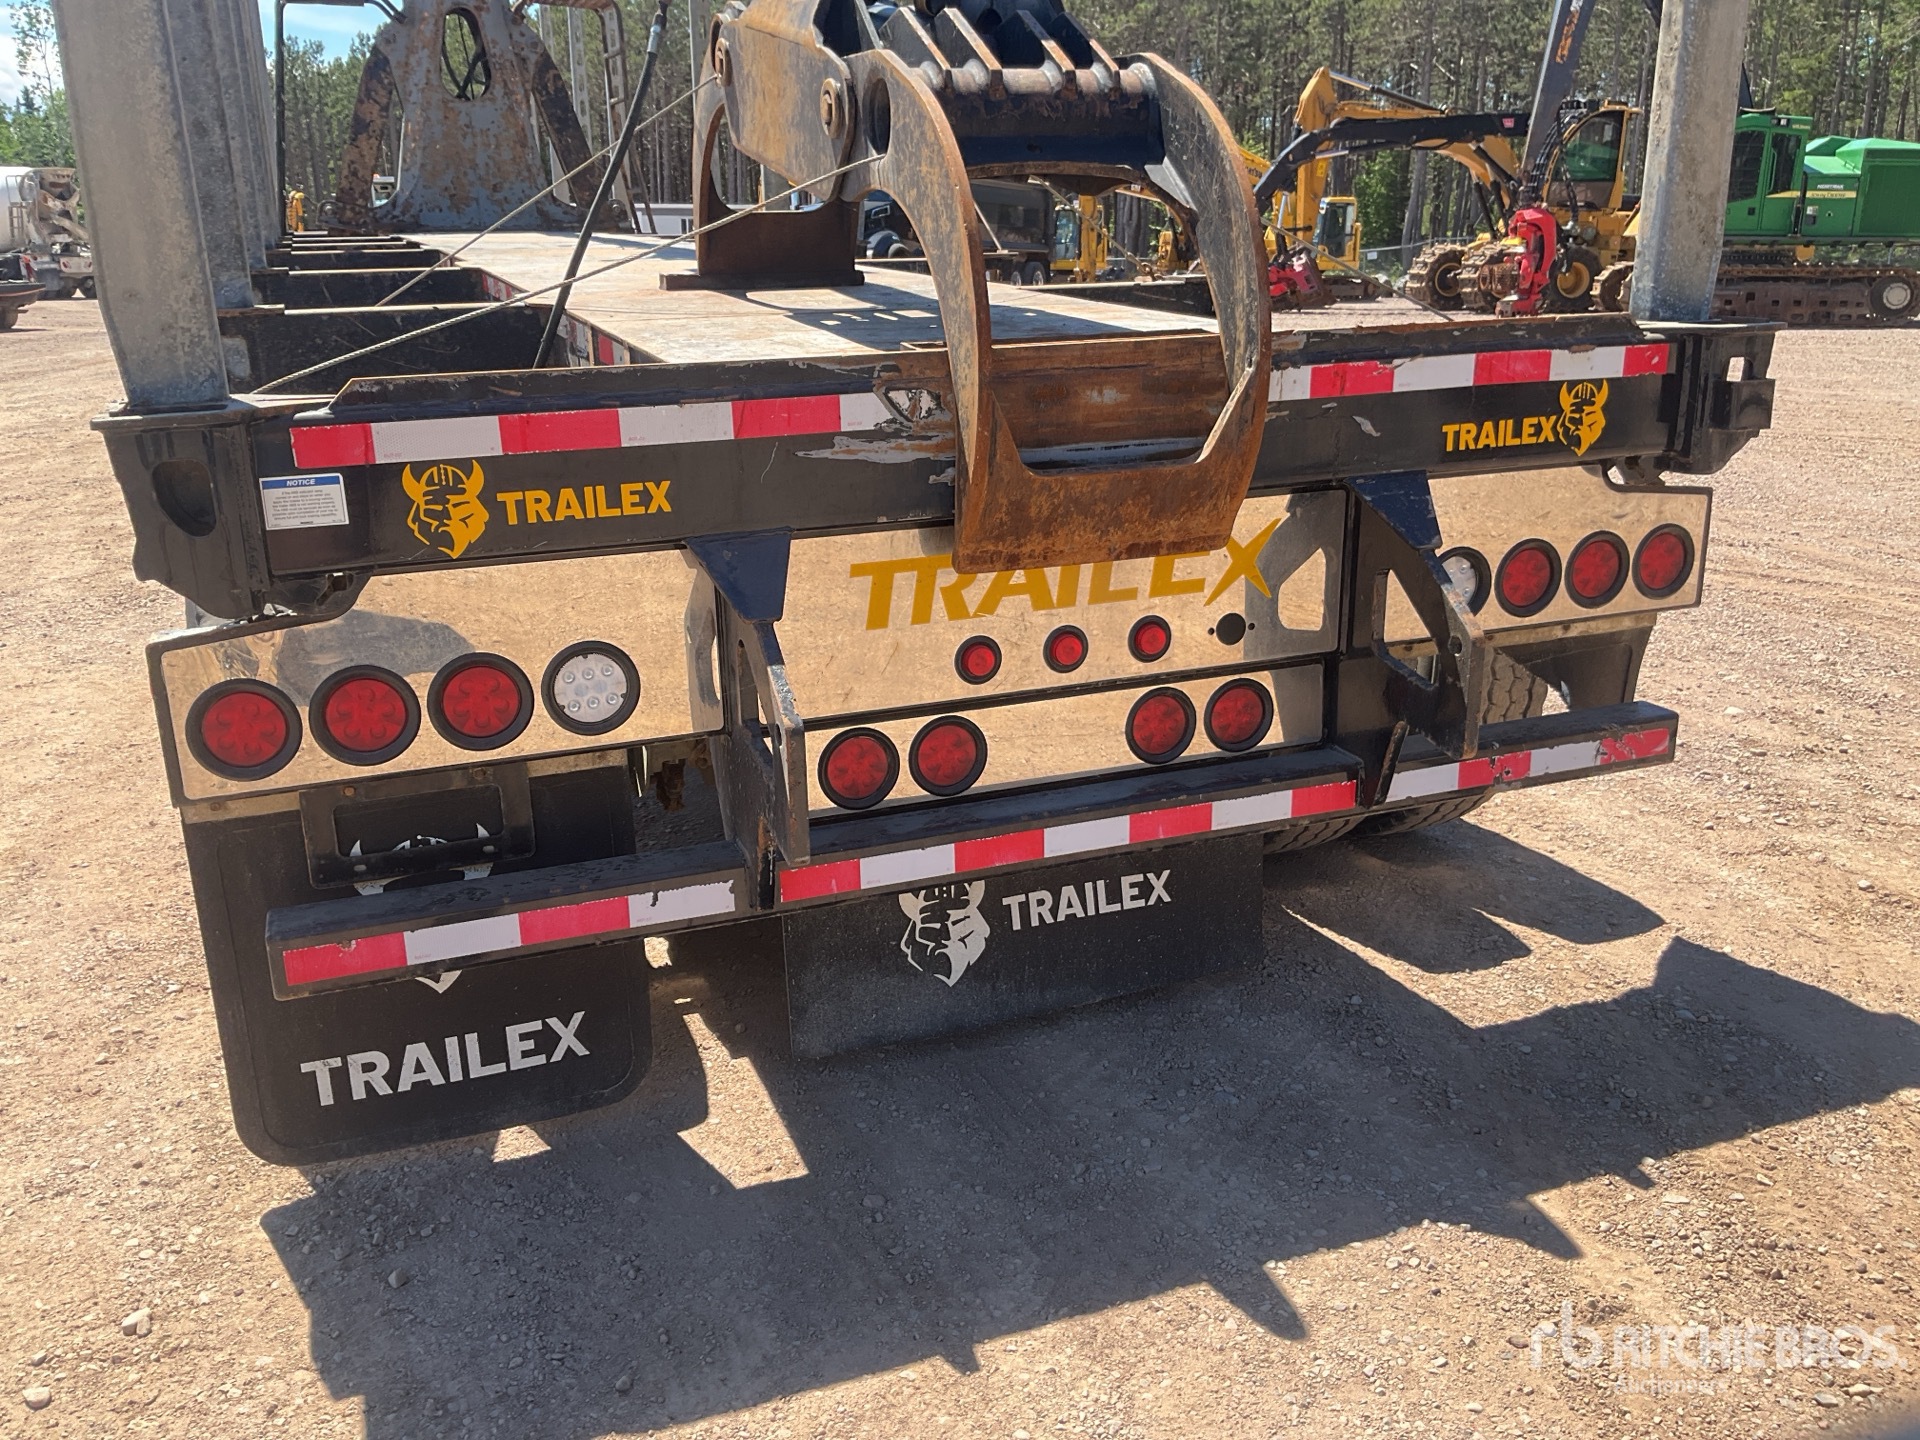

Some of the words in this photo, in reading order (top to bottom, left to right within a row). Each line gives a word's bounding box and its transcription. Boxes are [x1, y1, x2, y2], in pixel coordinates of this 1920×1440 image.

[1441, 415, 1557, 452] TRAILEX
[286, 478, 316, 487] NOTICE
[495, 480, 672, 526] TRAILEX
[849, 518, 1282, 631] TRAILEX
[1002, 869, 1172, 931] TRAILEX
[300, 1010, 590, 1107] TRAILEX
